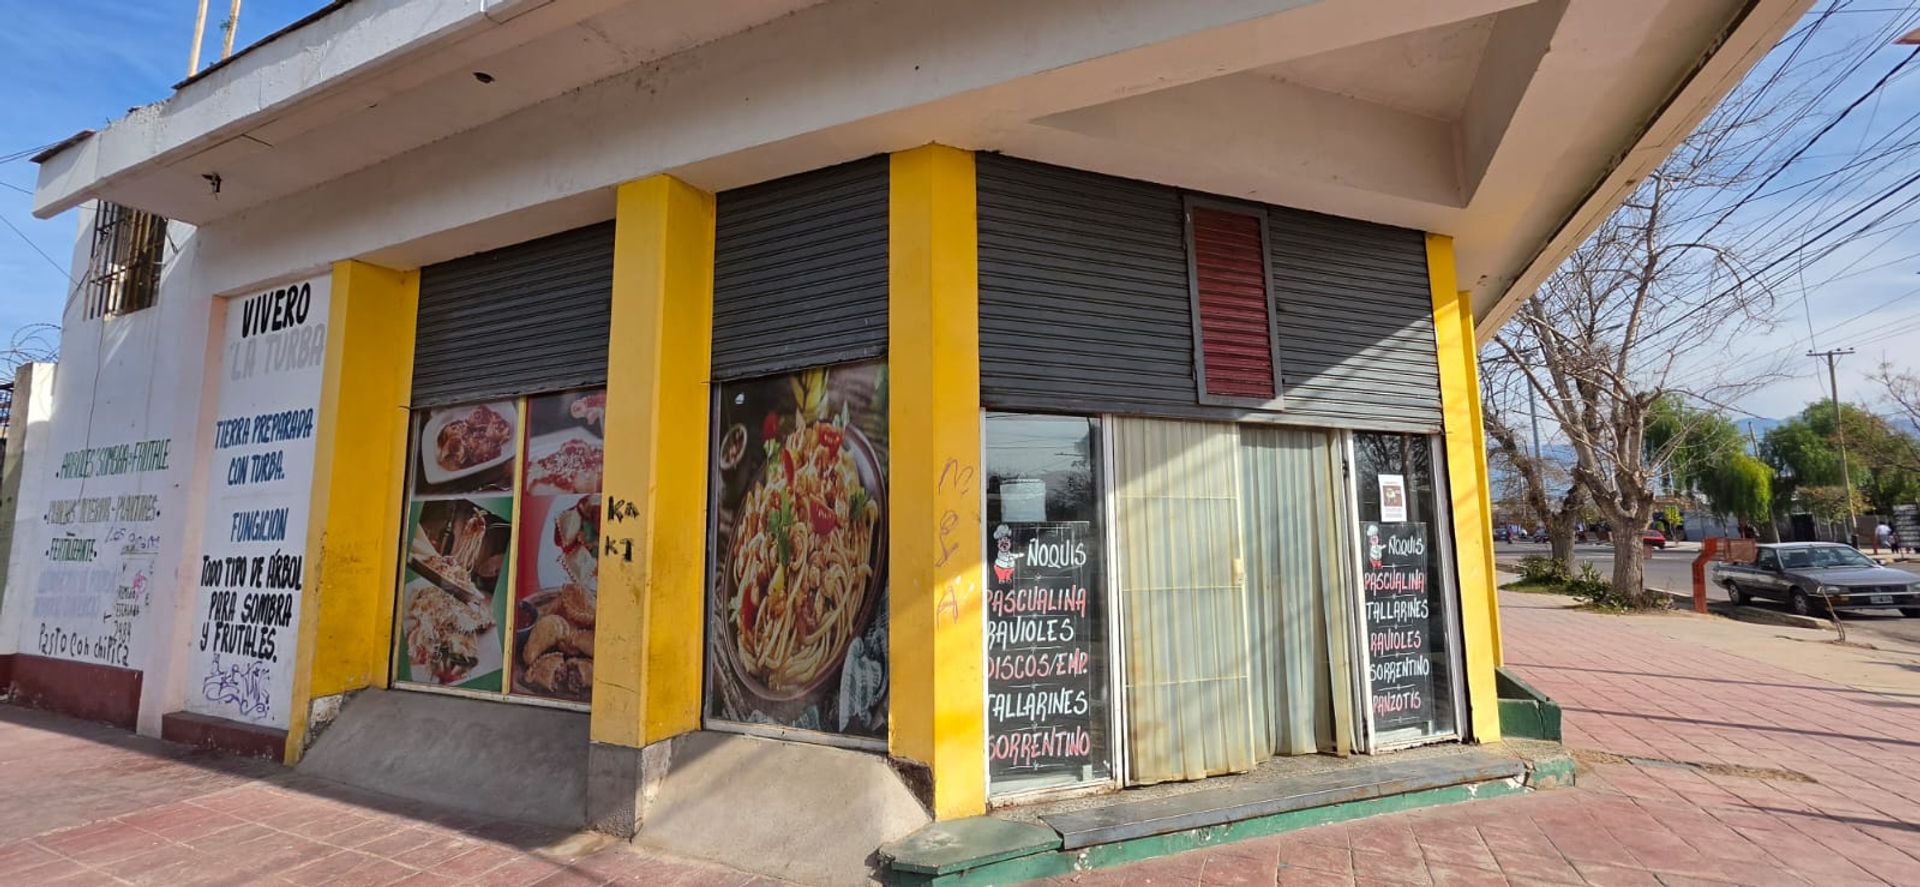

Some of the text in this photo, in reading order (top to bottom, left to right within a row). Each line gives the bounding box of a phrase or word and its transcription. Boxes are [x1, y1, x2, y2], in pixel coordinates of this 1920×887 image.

[242, 282, 311, 339] VIVERO
[264, 323, 326, 375] TURBA
[214, 408, 313, 450] TIERRA PREPARADA
[228, 450, 285, 486] CON TURBA.
[230, 507, 289, 542] FUNGICION
[1026, 538, 1087, 569] ÑOQUIS
[1388, 534, 1425, 557] ÑOQUIS
[225, 556, 247, 588] TIPO
[250, 556, 265, 589] DE
[266, 548, 303, 591] ÁRBOL
[1364, 568, 1425, 597] PASCUALINA
[208, 591, 293, 628] PARA SOMBRA
[1366, 596, 1429, 626] TALLARINES
[200, 621, 278, 663] Y FRUTALES.
[987, 615, 1075, 651] RAVIOLES
[1371, 627, 1421, 658] RAVIOLES
[1369, 655, 1430, 684] SORRENTINO
[988, 726, 1091, 766] SORRENTINO
